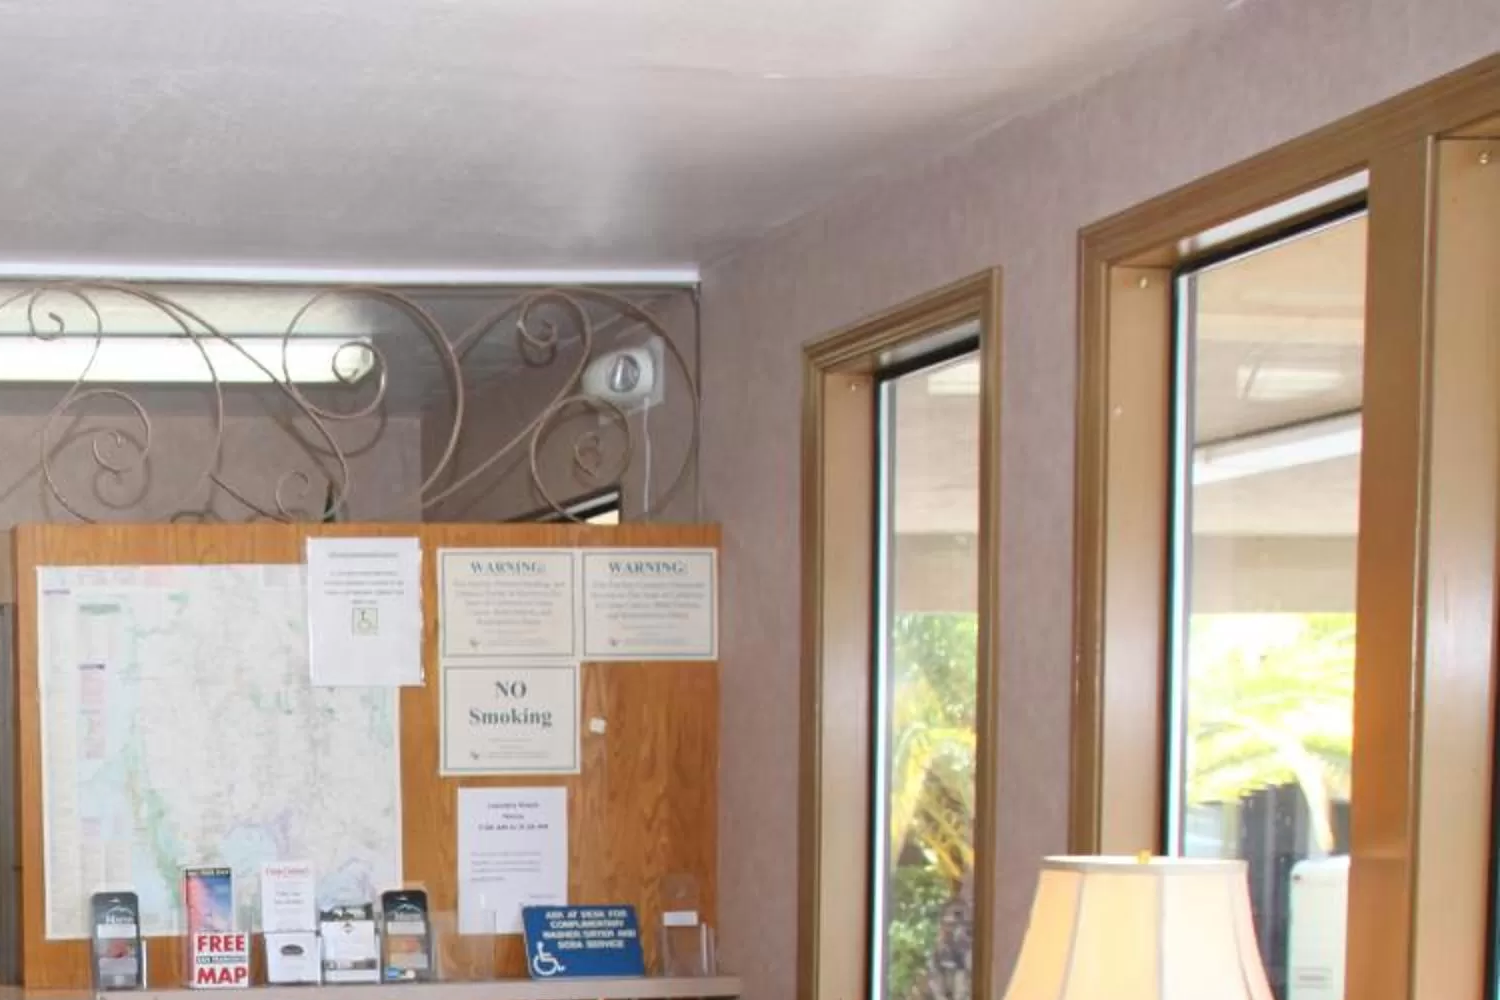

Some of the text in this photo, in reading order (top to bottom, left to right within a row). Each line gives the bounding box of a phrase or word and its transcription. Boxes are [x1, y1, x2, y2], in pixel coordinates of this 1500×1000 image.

[494, 679, 528, 700] NO
[468, 707, 553, 728] Smoking
[196, 933, 245, 953] FREE
[196, 964, 248, 985] MAP
